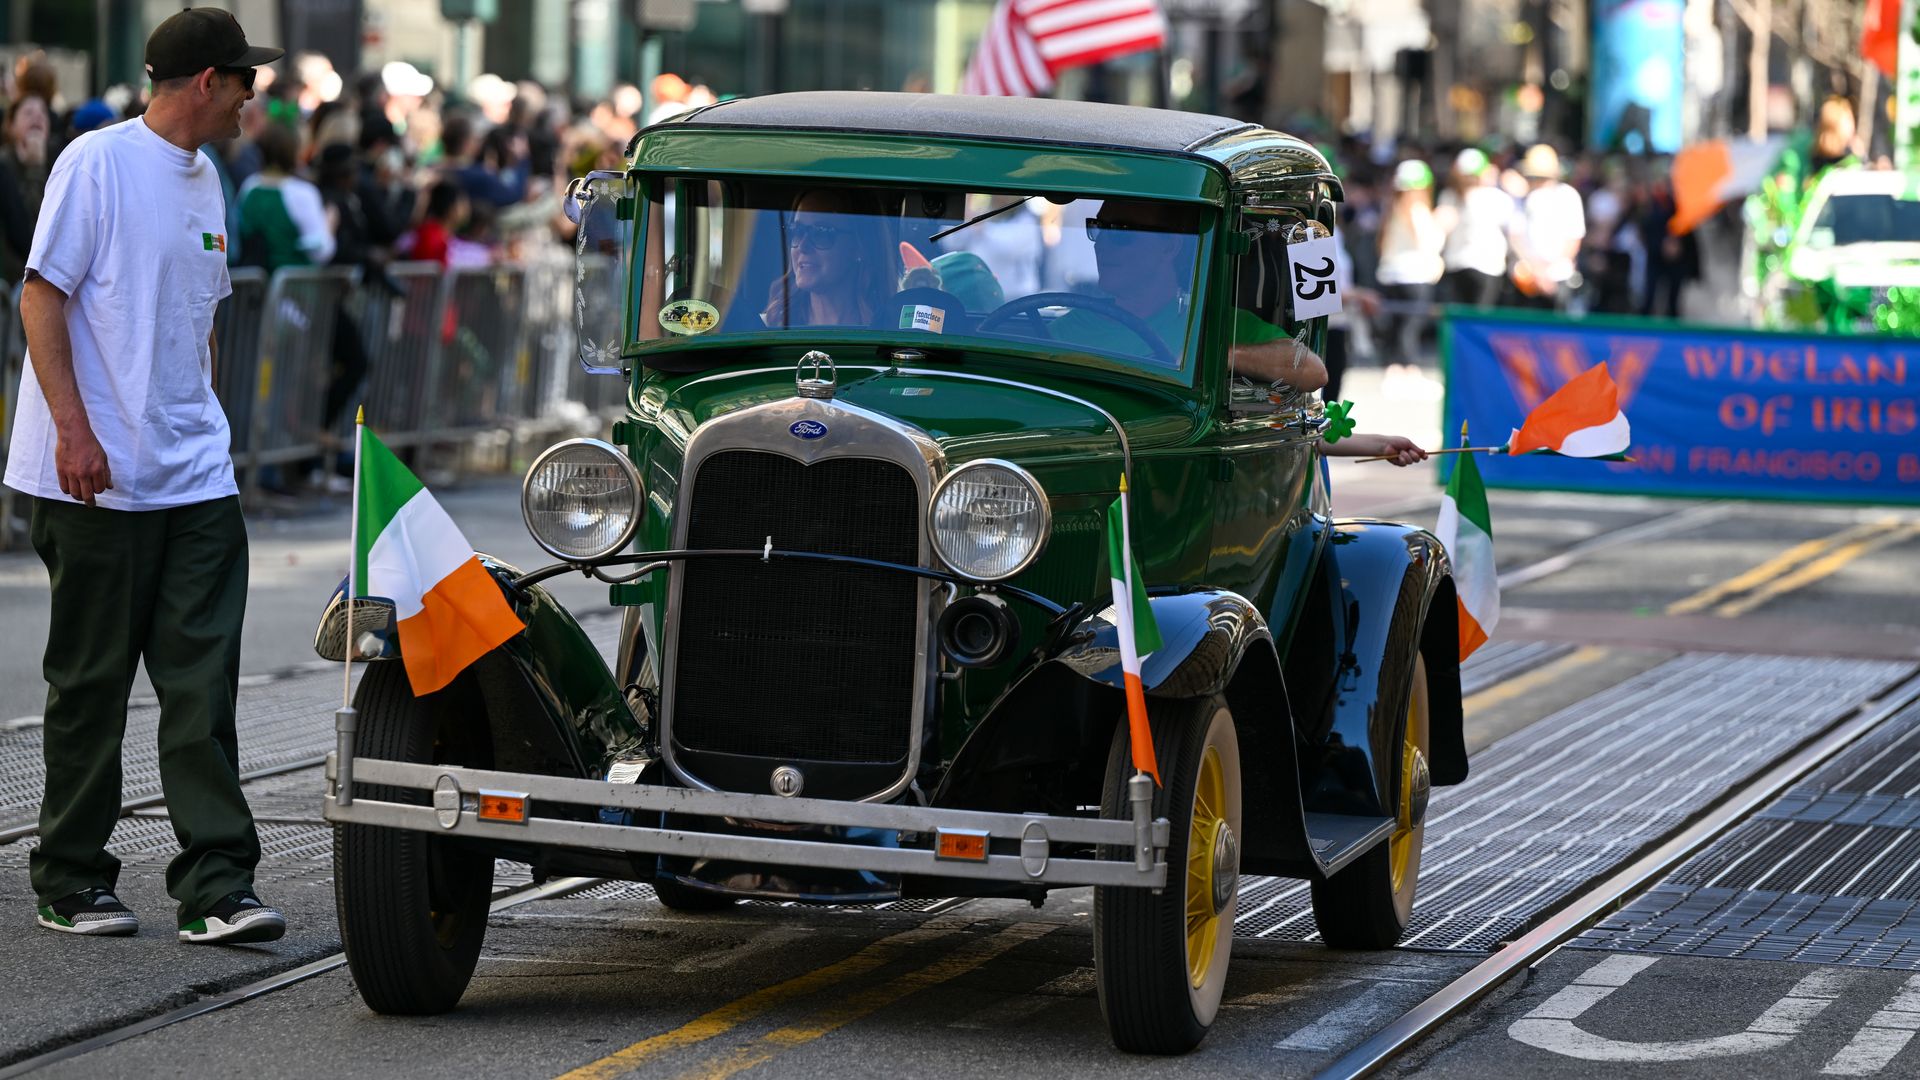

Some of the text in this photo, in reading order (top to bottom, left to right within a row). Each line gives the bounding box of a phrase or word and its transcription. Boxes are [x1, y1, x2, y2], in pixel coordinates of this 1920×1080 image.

[1294, 256, 1336, 301] 25
[794, 422, 822, 435] Ford
[1718, 392, 1794, 437] OF
[1688, 446, 1881, 482] FRANCISCO
